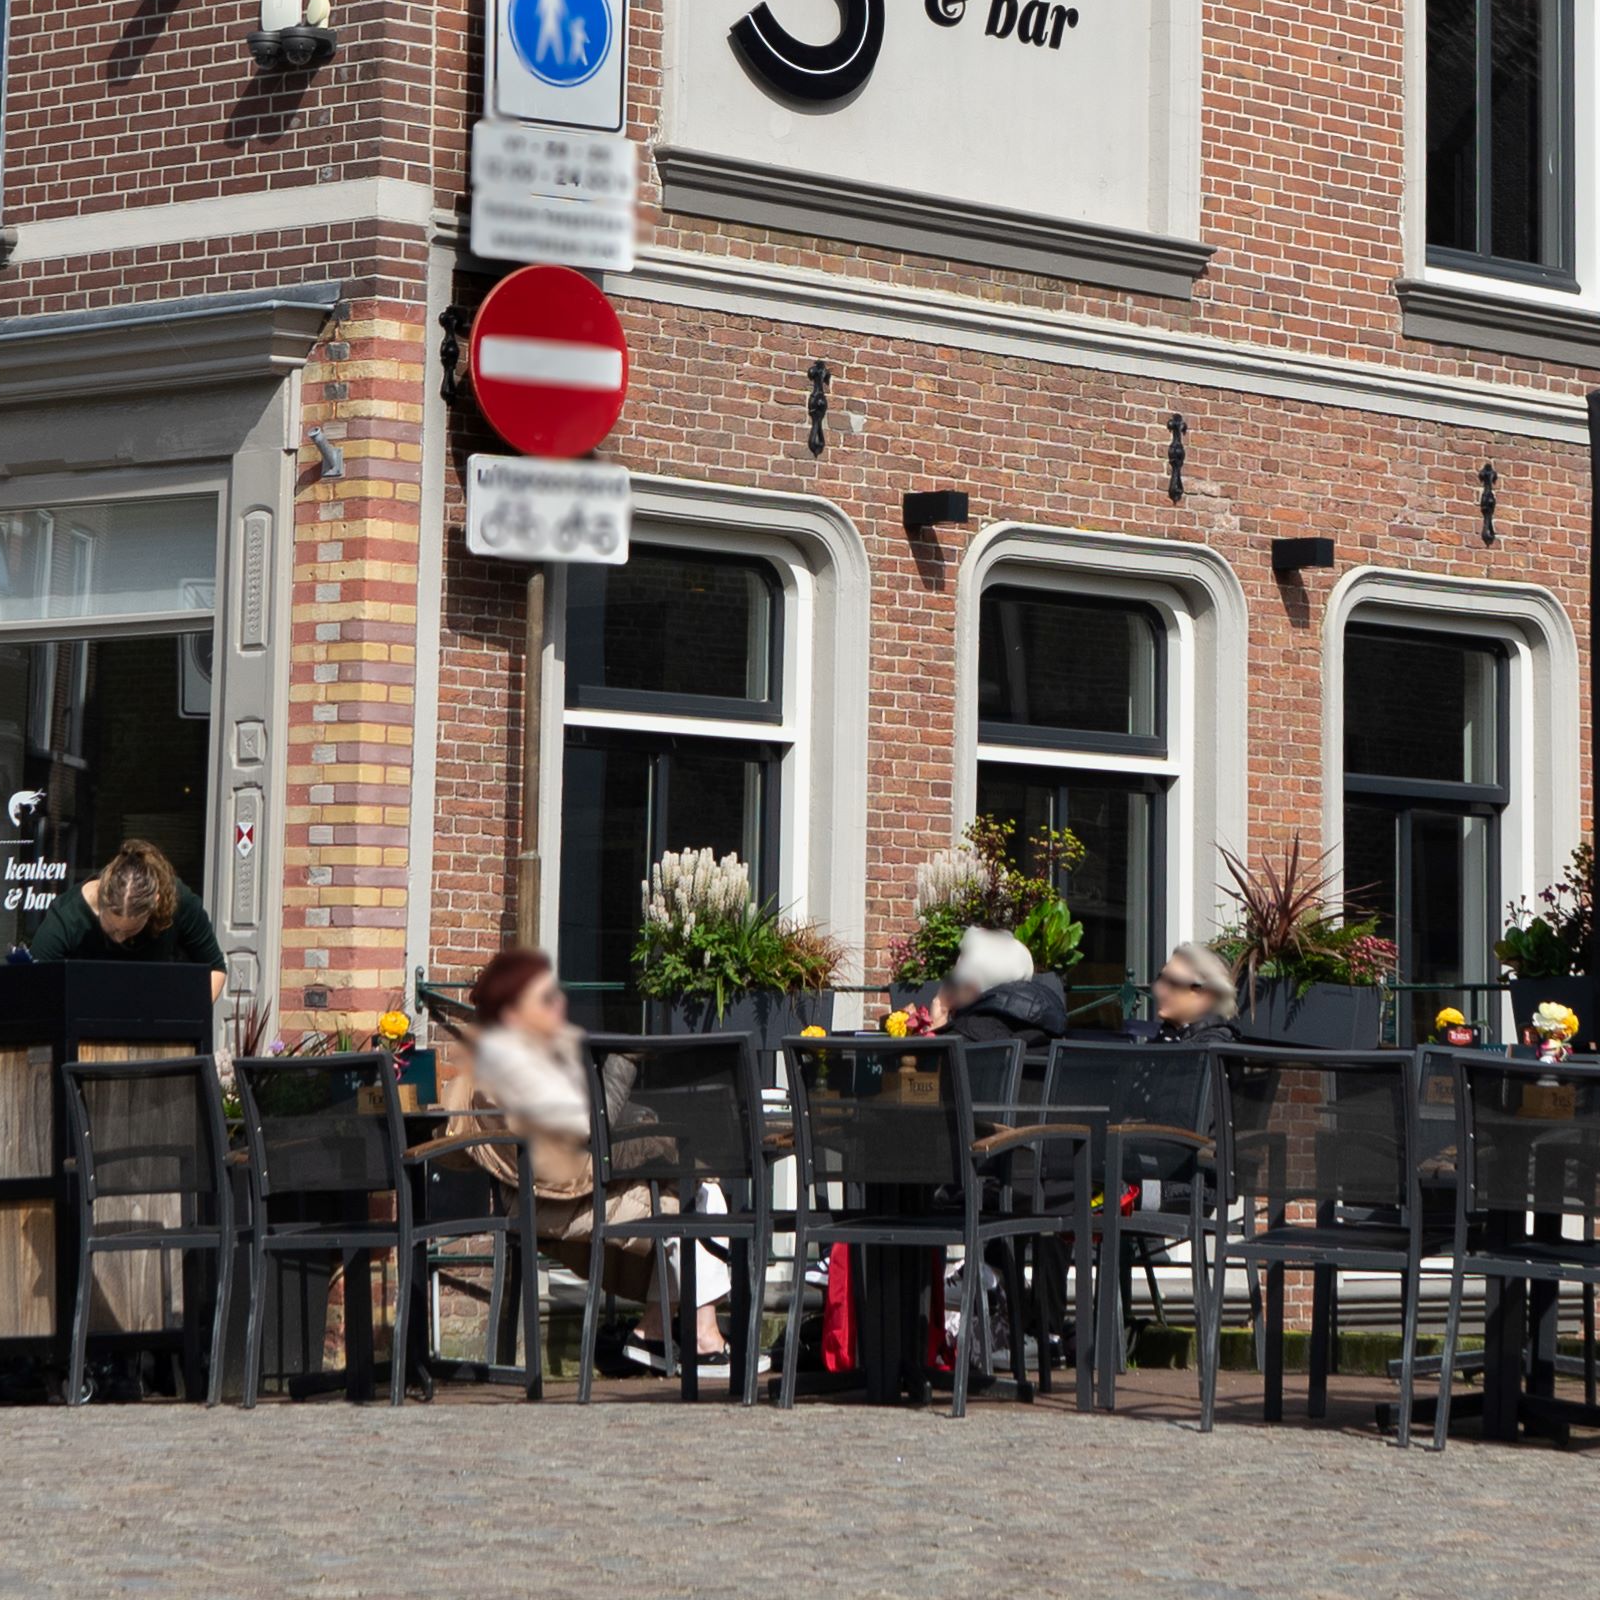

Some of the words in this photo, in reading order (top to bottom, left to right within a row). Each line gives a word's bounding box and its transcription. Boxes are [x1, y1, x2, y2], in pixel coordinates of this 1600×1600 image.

[4, 856, 67, 881] keuken
[4, 888, 23, 910] &
[23, 886, 56, 910] bar
